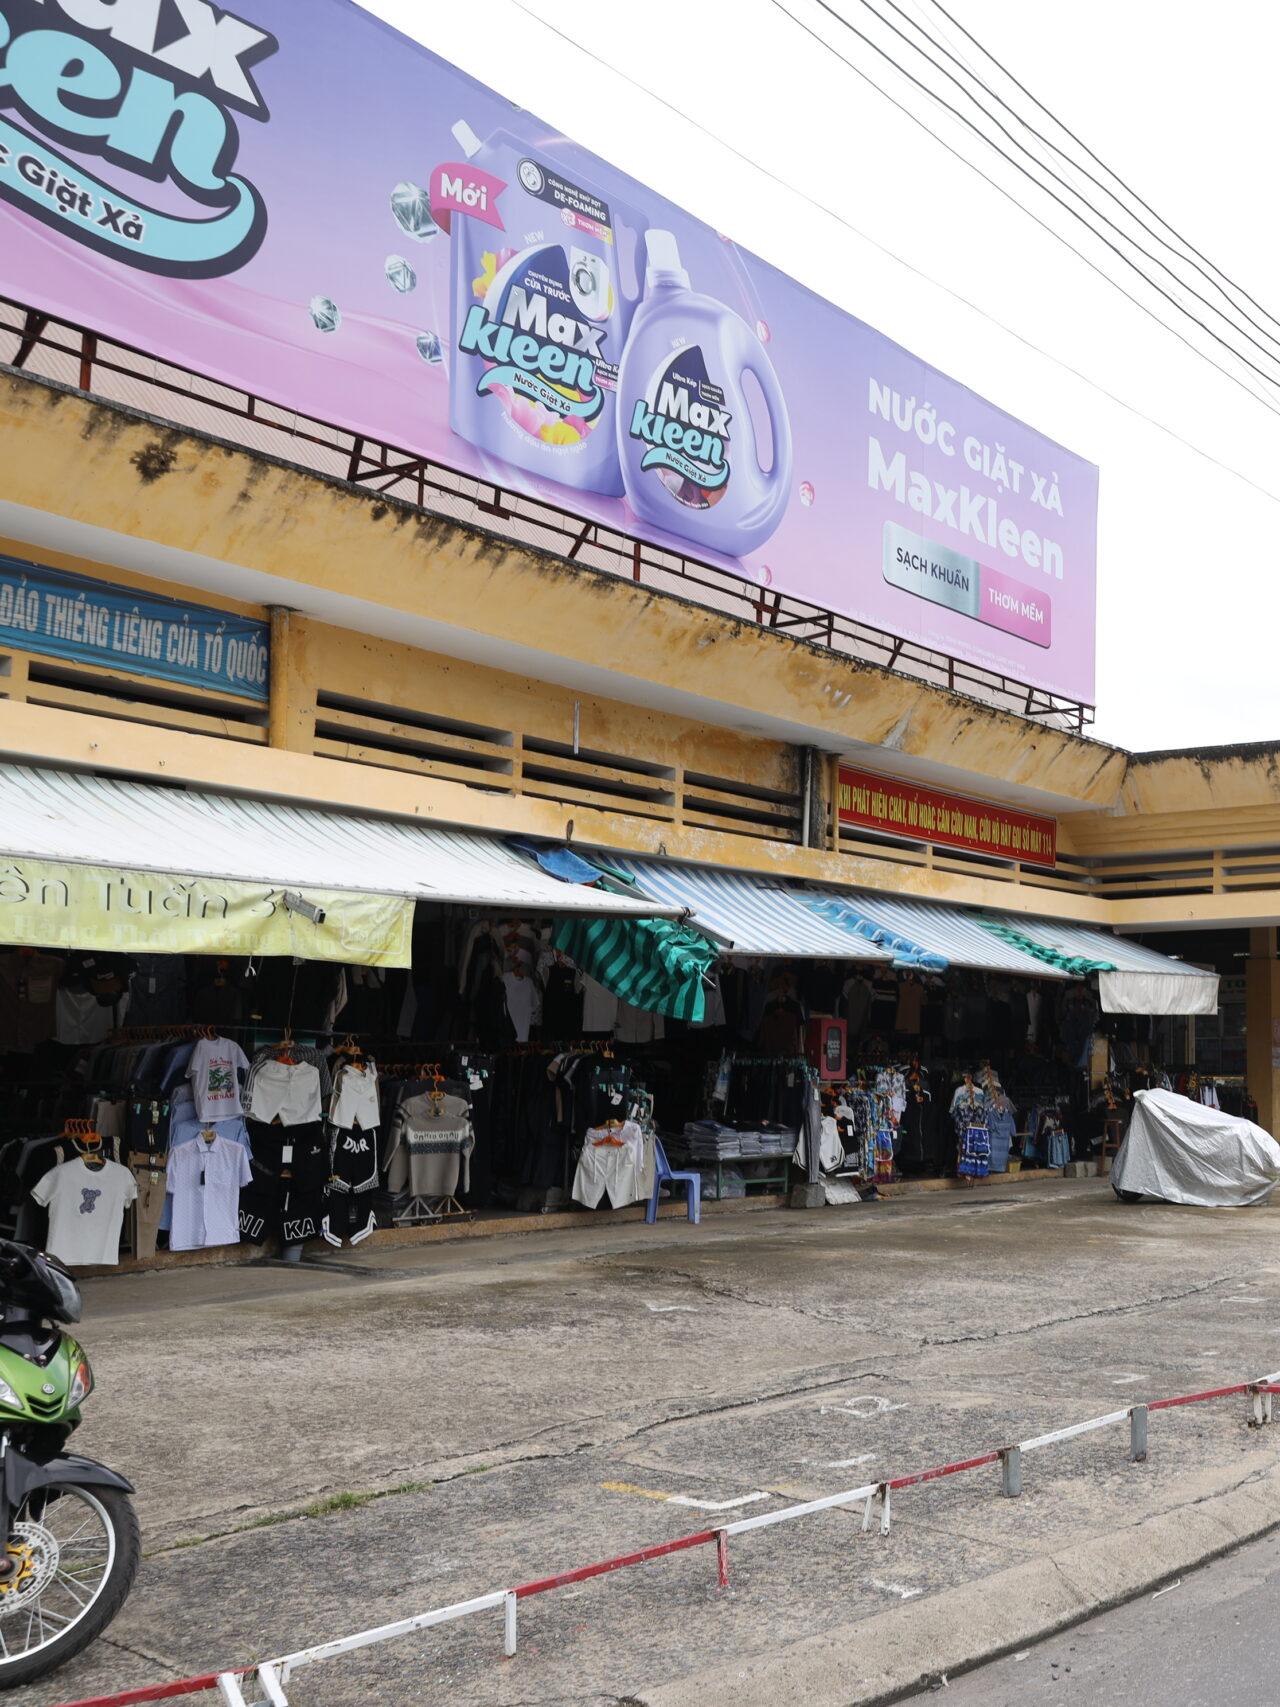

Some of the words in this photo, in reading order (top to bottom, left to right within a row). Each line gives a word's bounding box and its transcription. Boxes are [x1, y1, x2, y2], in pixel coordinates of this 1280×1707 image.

[440, 172, 488, 212] Mới
[554, 189, 606, 221] DE-FOAMING
[97, 199, 145, 242] Xả
[502, 284, 606, 359] Max
[460, 305, 596, 392] kleen
[513, 372, 539, 392] Nước
[630, 400, 723, 466] kleen
[657, 380, 732, 438] Max
[868, 377, 956, 456] NƯỚC
[963, 435, 1025, 494] GIẶT
[1030, 470, 1064, 518] XẢ
[867, 436, 1064, 580] MaxKleen
[896, 547, 928, 575] SẠCH
[931, 562, 970, 592] KHUẨN
[988, 587, 1019, 614] THƠM
[1021, 602, 1044, 625] MỀM
[113, 606, 163, 660] LIÊNG
[166, 613, 198, 669] CỦA
[203, 620, 227, 674] TỔ
[226, 630, 267, 684] QUỐC
[852, 783, 871, 815] PHÁT
[871, 787, 888, 824] HIỆN
